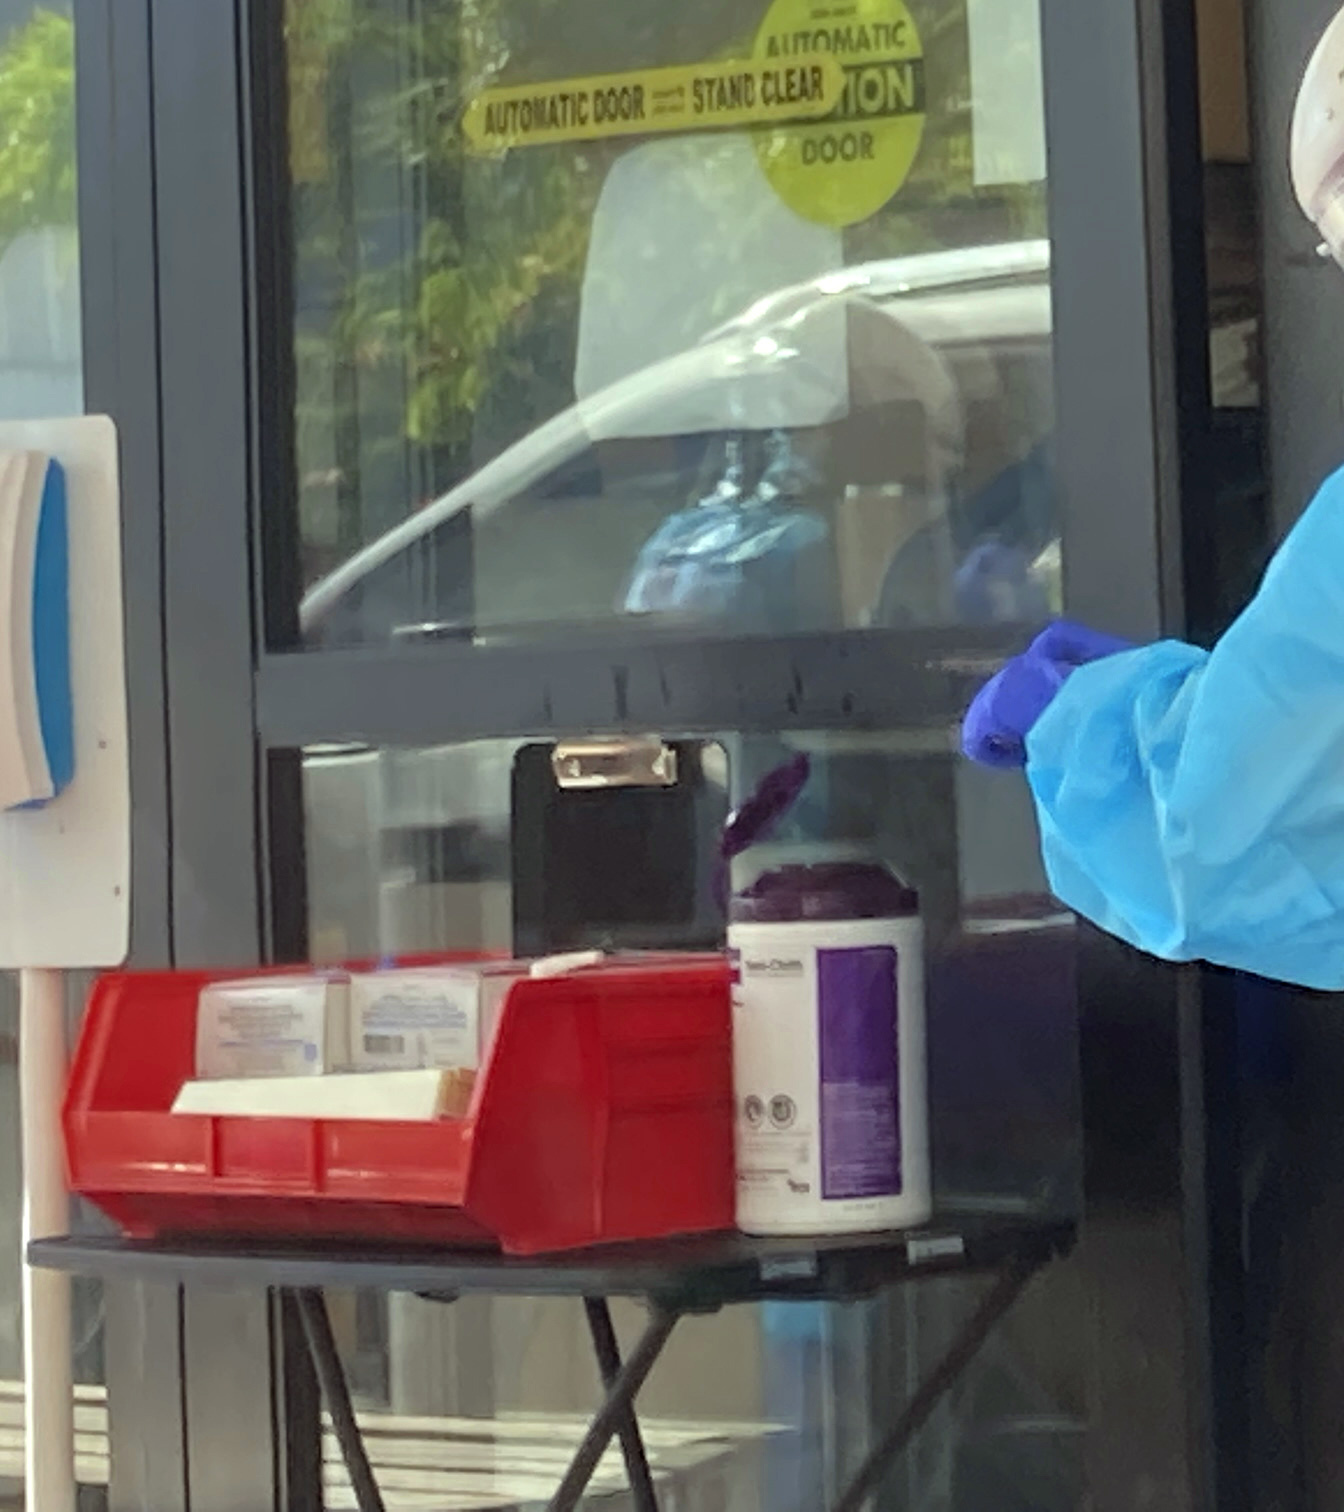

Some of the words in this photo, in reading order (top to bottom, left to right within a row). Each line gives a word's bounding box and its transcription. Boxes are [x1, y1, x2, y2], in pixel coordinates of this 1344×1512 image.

[766, 20, 906, 59] AUTOMATIC
[484, 91, 589, 137] AUTOMATIC
[593, 84, 646, 125] DOOR
[692, 73, 757, 115] STAND
[760, 65, 825, 107] CLEAR
[802, 131, 875, 166] DOOR
